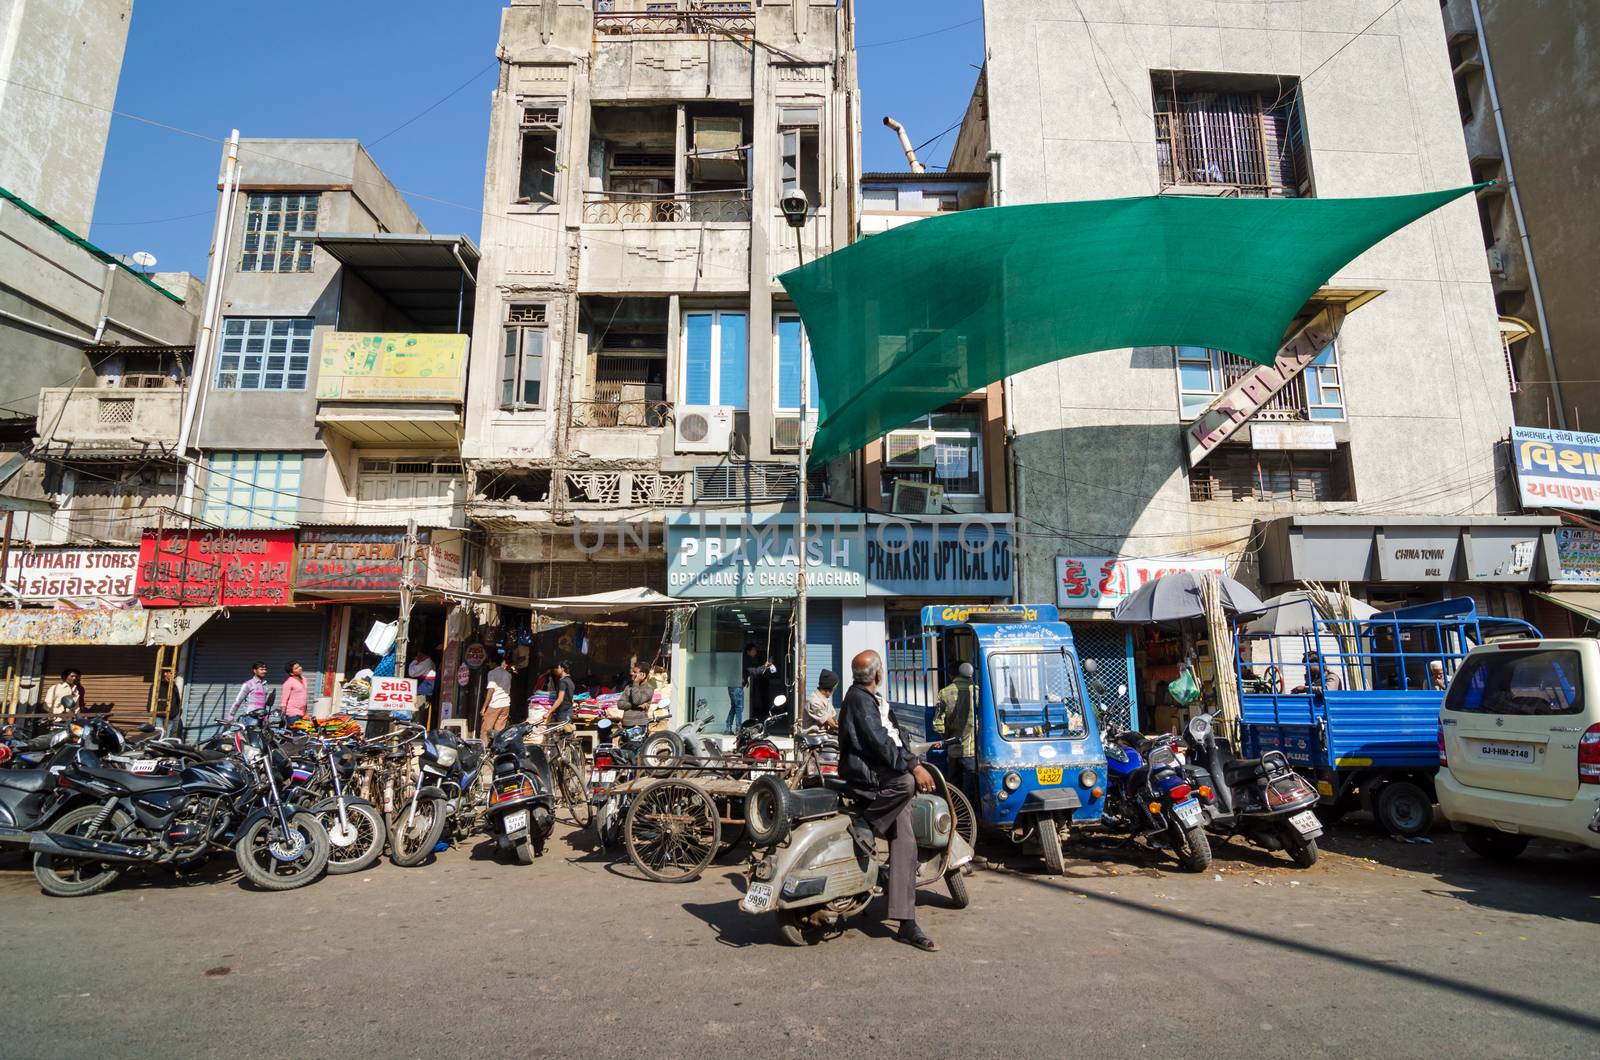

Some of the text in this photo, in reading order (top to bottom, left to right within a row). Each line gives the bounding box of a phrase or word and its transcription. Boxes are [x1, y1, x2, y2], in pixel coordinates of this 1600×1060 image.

[1241, 329, 1333, 406] PLAZA
[679, 537, 850, 567] PRAKASH
[1395, 549, 1444, 560] CHINA TOWN
[14, 553, 81, 569] KOTHARI
[85, 553, 138, 569] STORES
[868, 540, 929, 581] PRAKASH
[934, 540, 988, 581] OPTICAL
[670, 572, 741, 586] OPTICIANS
[745, 572, 755, 586] &
[380, 680, 412, 692] સાડી
[373, 693, 414, 703] કવર
